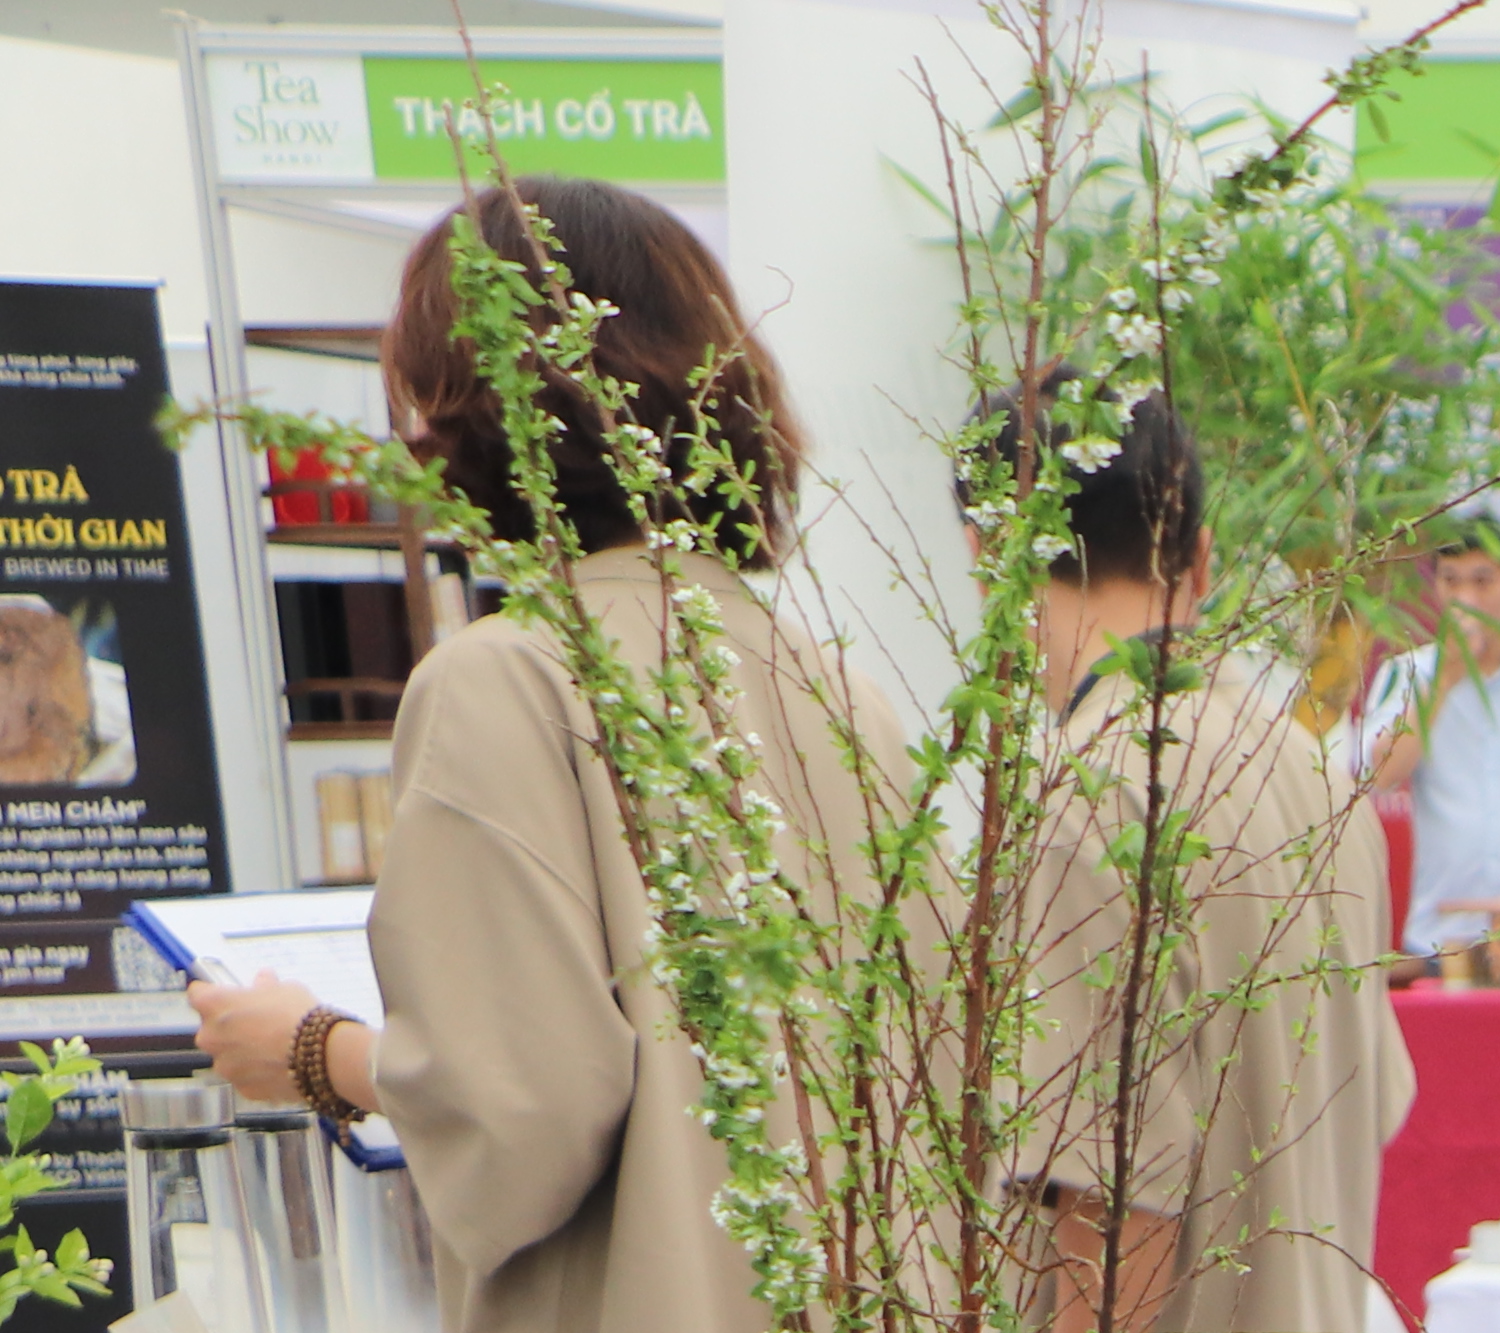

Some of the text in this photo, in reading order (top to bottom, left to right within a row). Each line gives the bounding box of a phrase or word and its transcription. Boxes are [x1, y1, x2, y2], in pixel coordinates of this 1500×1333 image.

[245, 62, 318, 104] Tea
[234, 105, 339, 146] Show
[625, 91, 712, 138] TRÀ
[79, 518, 167, 549] GIAN
[4, 557, 169, 578] BREWED IN TIME
